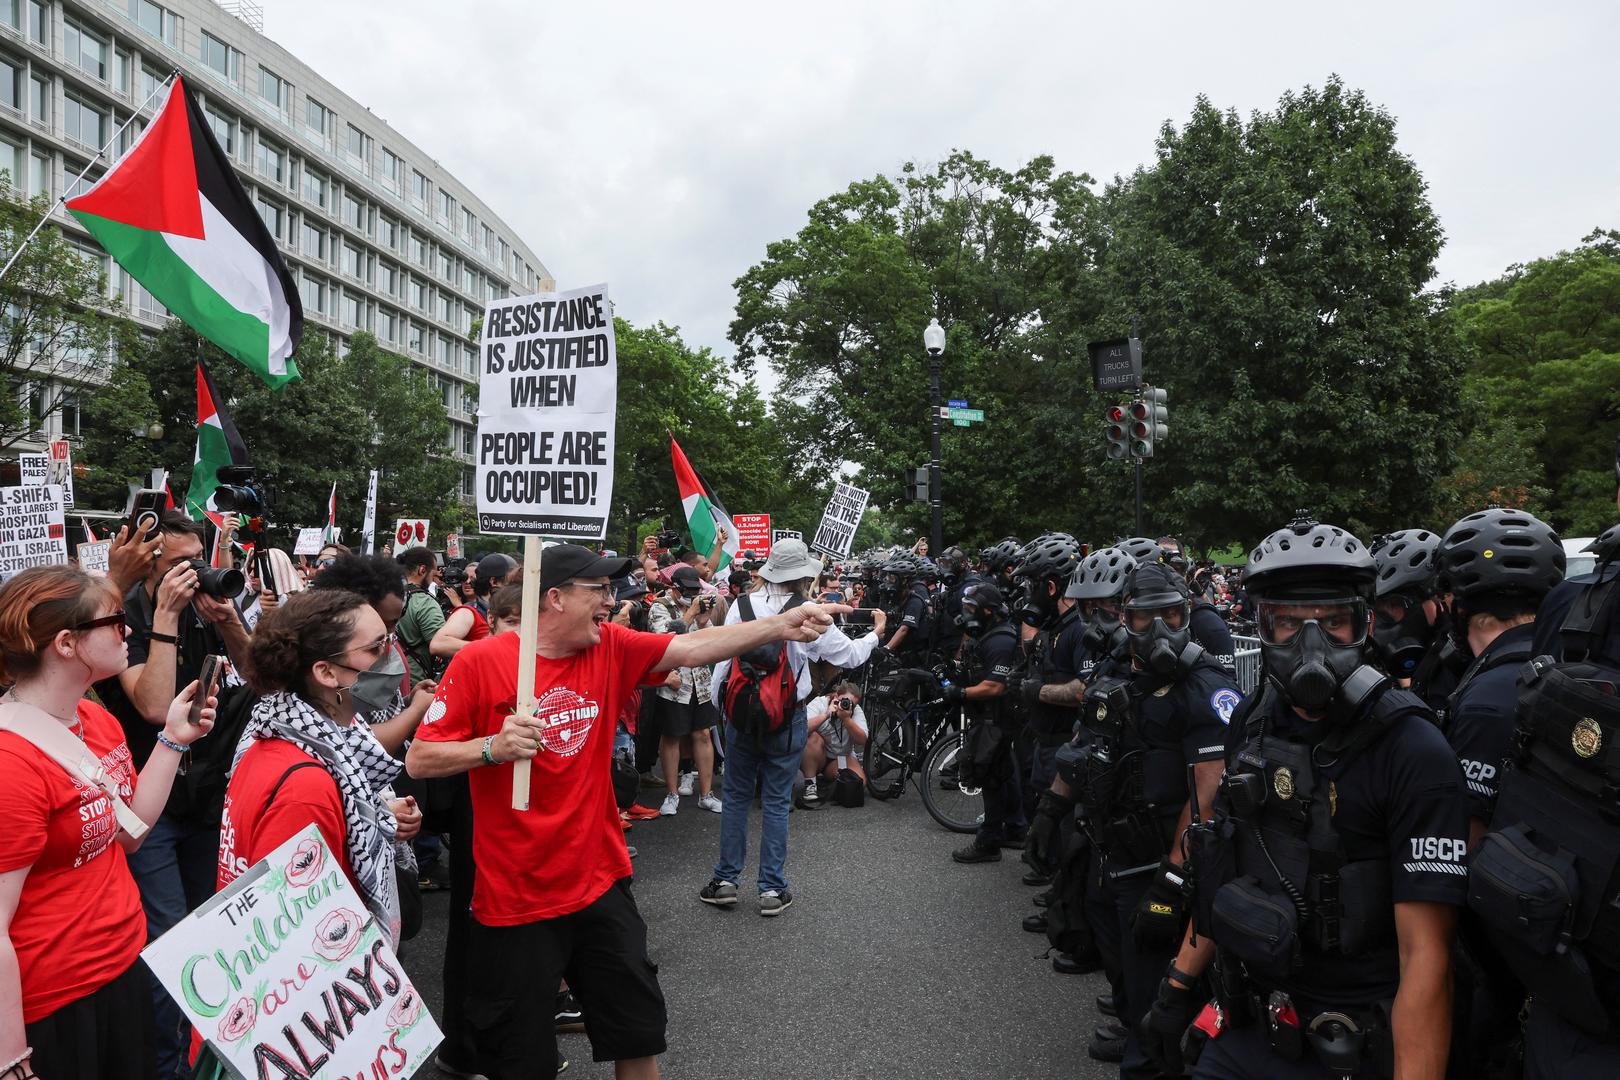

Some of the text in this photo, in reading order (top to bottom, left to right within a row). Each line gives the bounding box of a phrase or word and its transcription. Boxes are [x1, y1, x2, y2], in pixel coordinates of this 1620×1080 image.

[487, 294, 606, 338] RESISTANCE
[486, 333, 608, 374] IS JUSTIFIED
[1110, 348, 1122, 357] ALL
[1104, 361, 1129, 371] TRUCKS
[1100, 374, 1134, 384] TURN LEFT
[511, 375, 576, 408] WHEN
[481, 431, 607, 465] PEOPLE ARE
[22, 457, 47, 467] FREE
[0, 487, 51, 505] L-SHIFA
[486, 470, 598, 505] OCCUPIED!
[848, 487, 867, 502] WITH
[7, 505, 22, 515] THE
[25, 502, 58, 514] LARGEST
[826, 501, 860, 525] END THE
[3, 527, 46, 543] IN GAZA
[491, 519, 506, 529] Party
[507, 520, 517, 528] for
[552, 522, 566, 530] and
[567, 522, 601, 532] Liberation
[775, 531, 800, 541] FREE
[0, 540, 62, 558] NTIL ISRAEL
[816, 525, 850, 554] NOW!
[0, 553, 64, 572] ESTROYED IT
[543, 705, 599, 729] LESTINE
[561, 748, 579, 757] FREE
[1460, 759, 1497, 782] SCP
[79, 797, 108, 821] STOP
[1411, 837, 1467, 862] USCP
[219, 886, 259, 926] THE
[262, 963, 317, 1015] are
[254, 939, 400, 1080] ALWAYS
